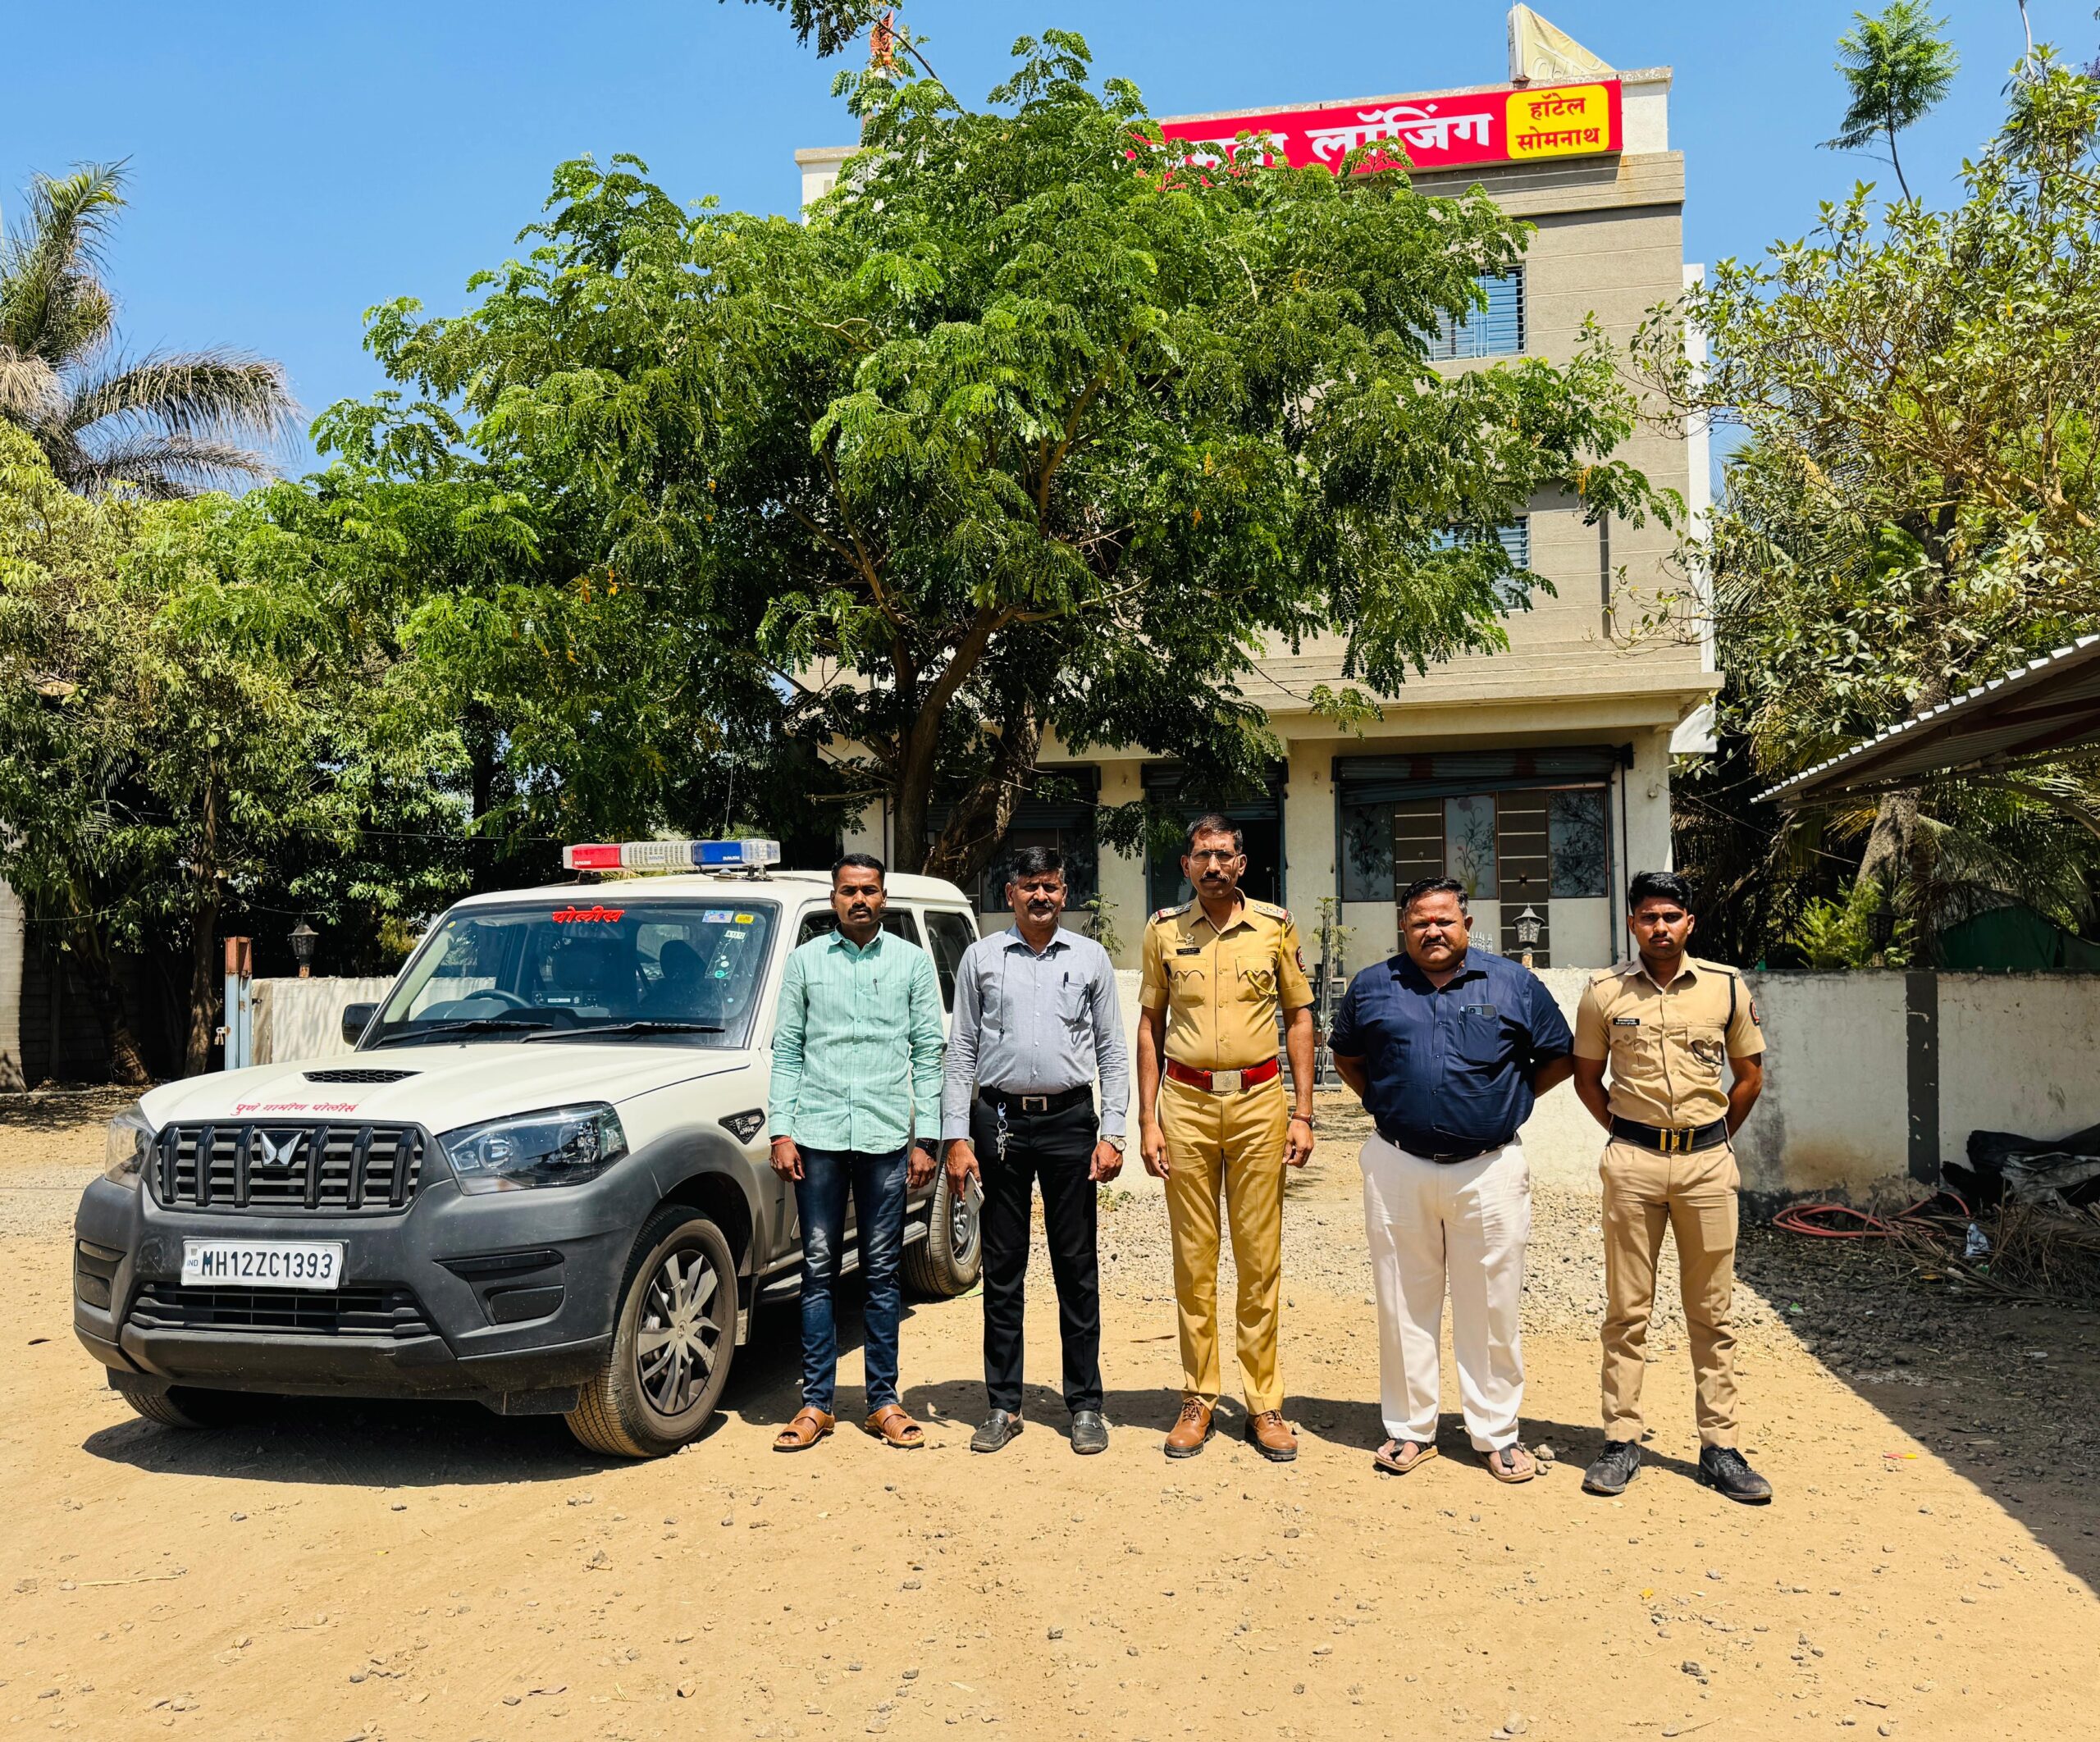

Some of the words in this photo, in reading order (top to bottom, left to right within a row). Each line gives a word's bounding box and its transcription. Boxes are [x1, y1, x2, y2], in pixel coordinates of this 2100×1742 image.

[1528, 93, 1586, 120] हॉटेल
[1304, 103, 1495, 162] लॉजिंग
[1516, 126, 1600, 151] सोमनाथ
[552, 905, 626, 923] पोलीस
[231, 1102, 260, 1116] पुणे
[312, 1102, 359, 1112] पोलीस
[201, 1251, 334, 1279] MH12ZC1393
